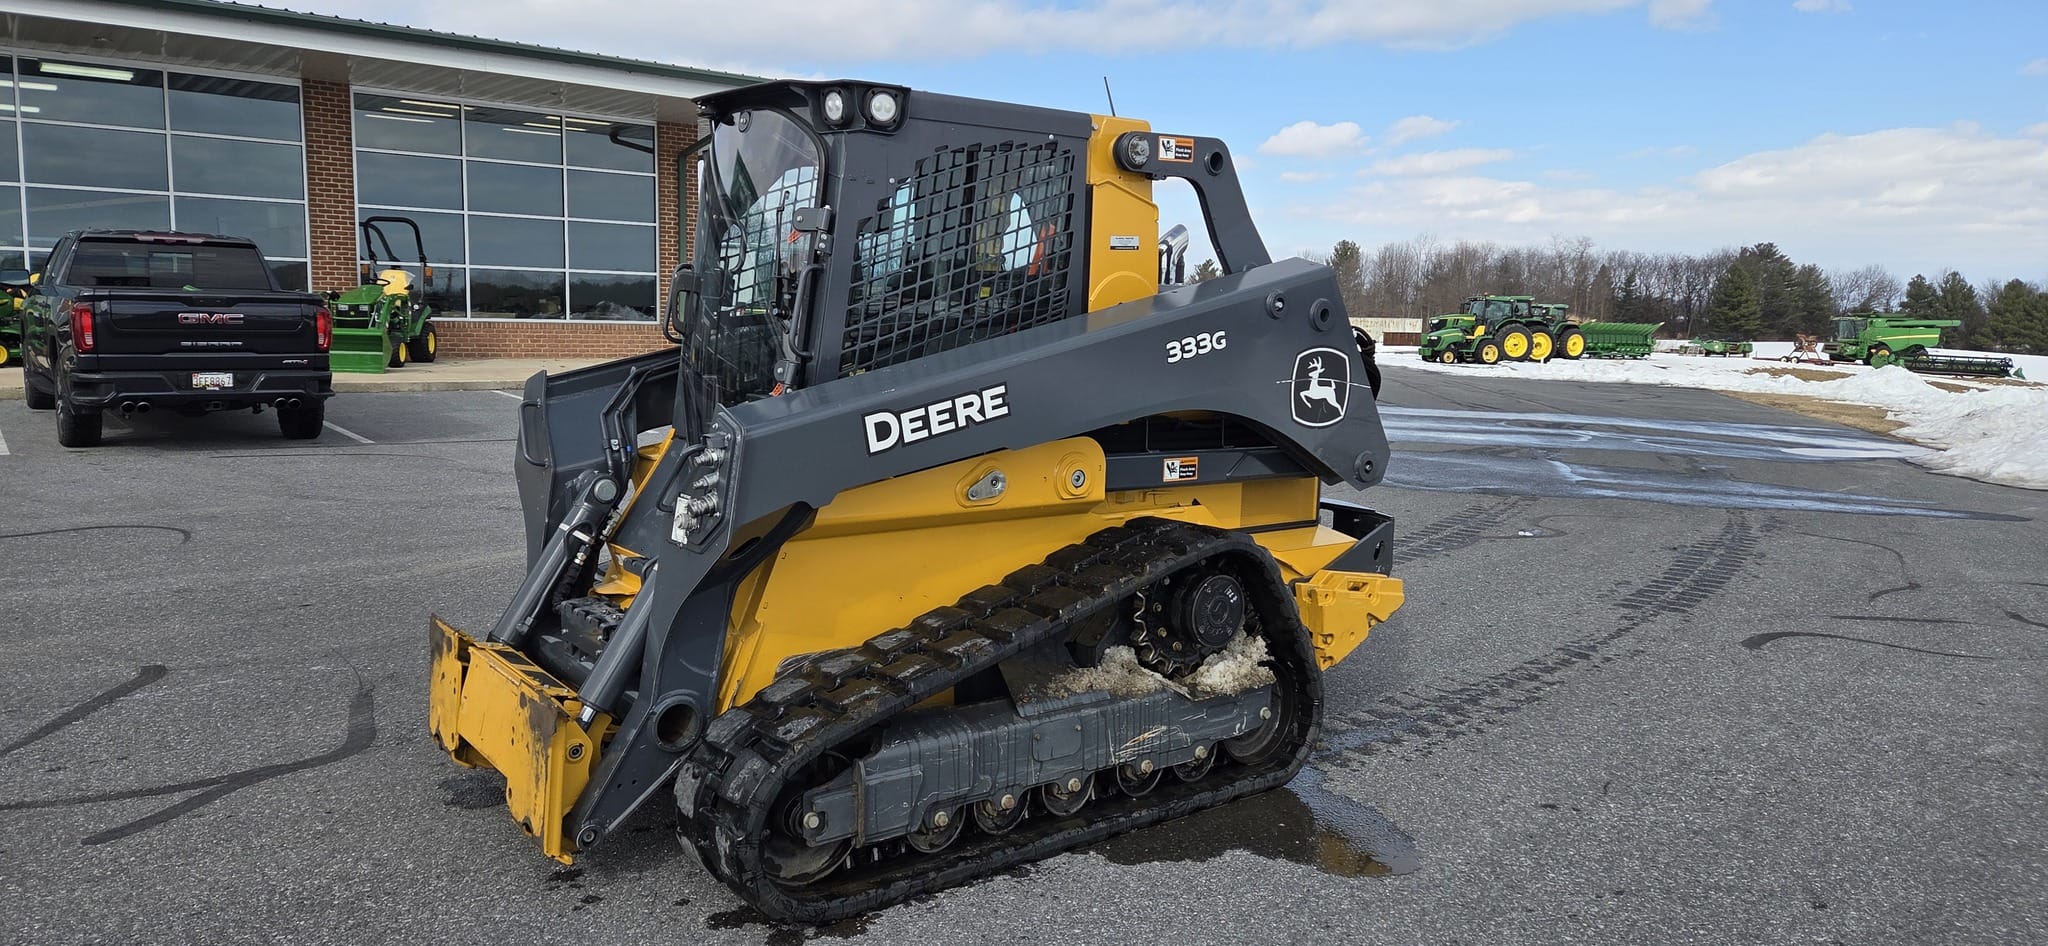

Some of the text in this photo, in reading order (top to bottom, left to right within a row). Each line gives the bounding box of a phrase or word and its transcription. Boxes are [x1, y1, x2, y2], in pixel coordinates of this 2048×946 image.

[178, 312, 244, 325] GMC
[1166, 330, 1227, 364] 333G
[864, 384, 1009, 454] DEERE
